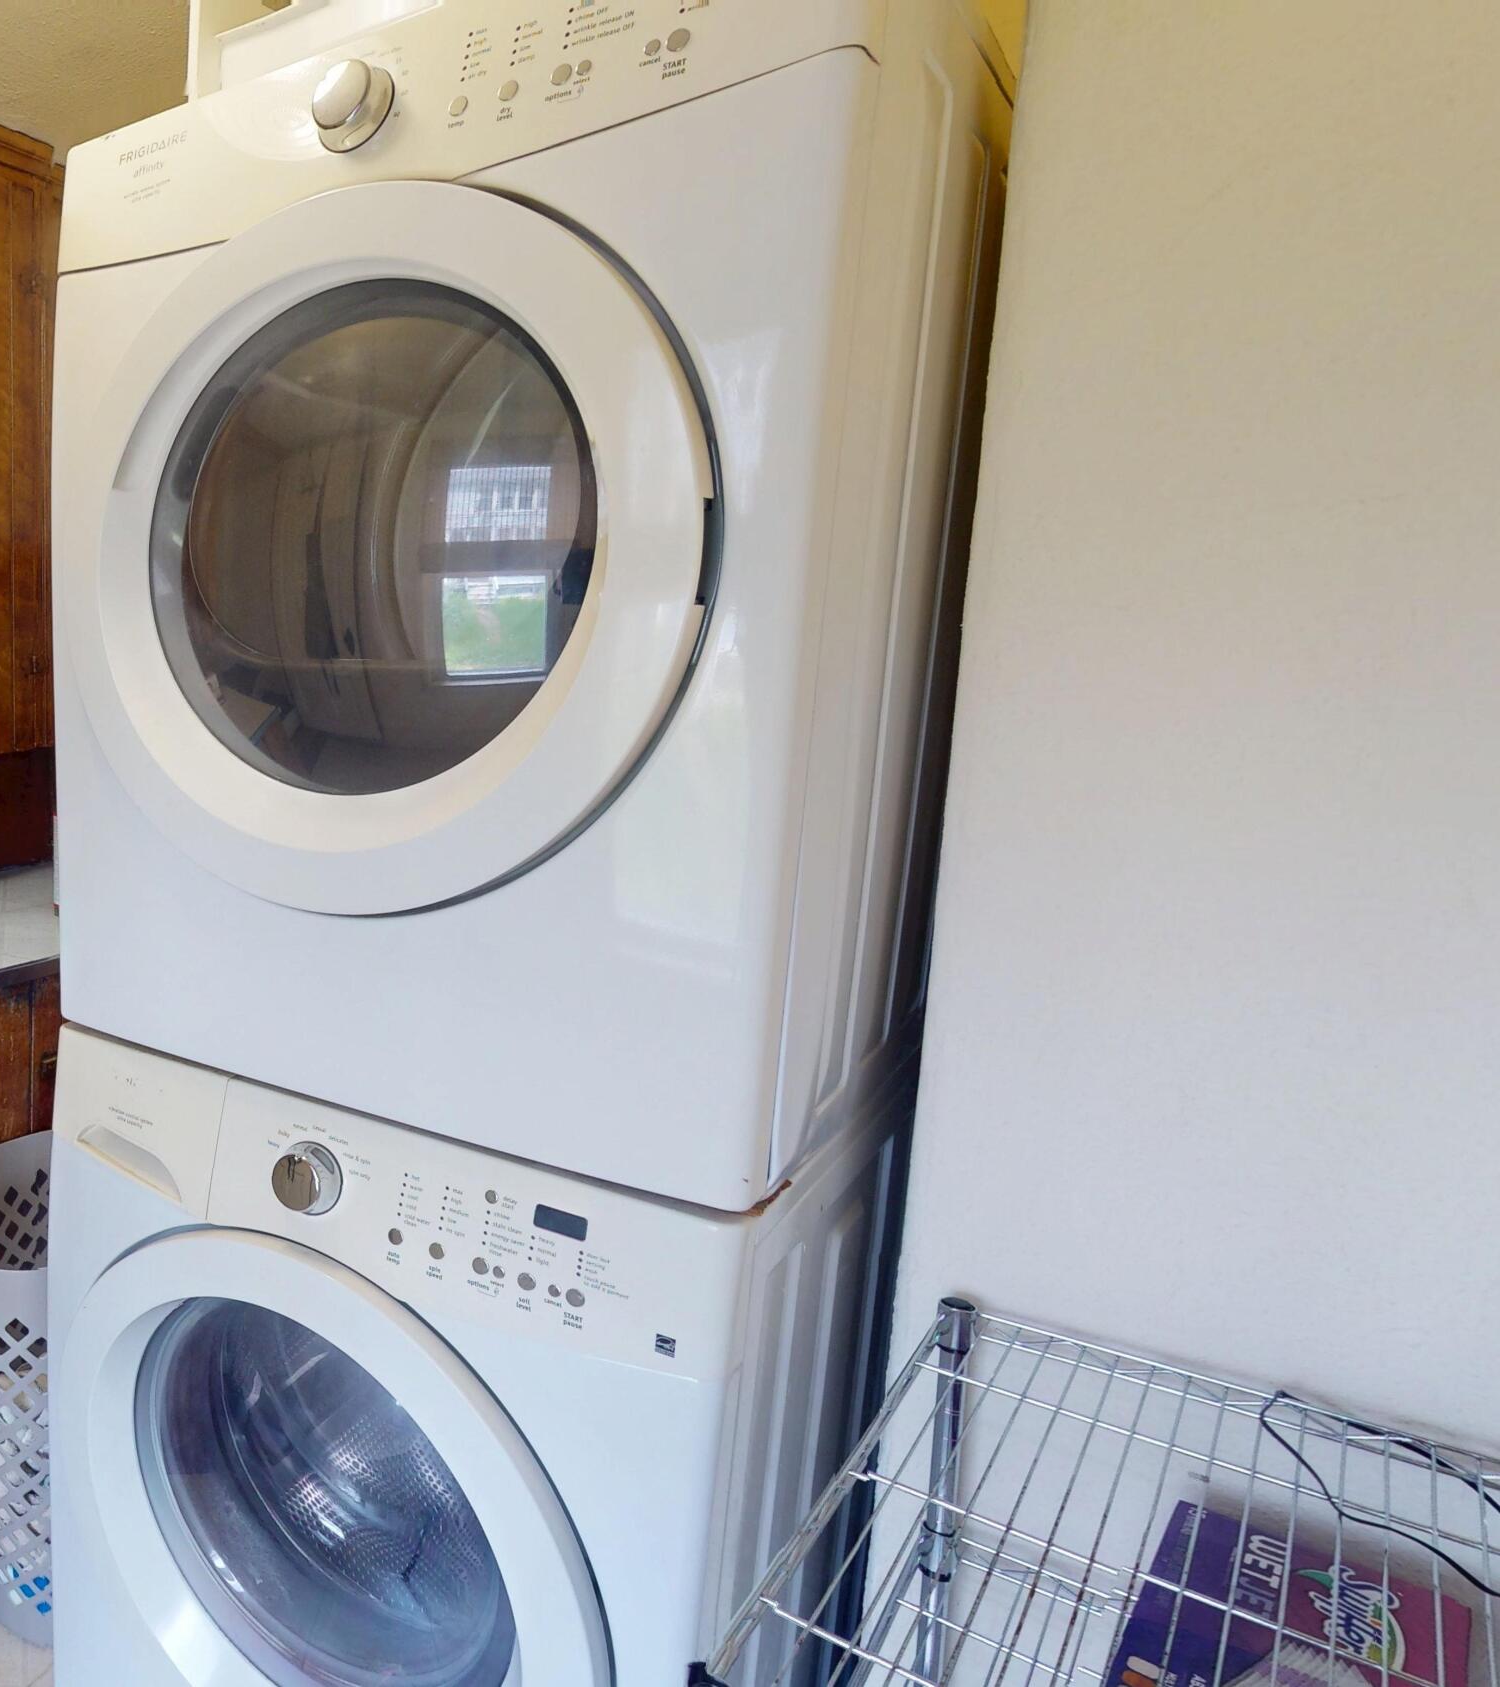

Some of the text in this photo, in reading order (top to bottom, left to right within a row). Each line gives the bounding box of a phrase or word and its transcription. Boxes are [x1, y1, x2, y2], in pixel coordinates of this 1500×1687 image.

[573, 22, 597, 34] wrinkle
[598, 15, 623, 26] release
[571, 21, 635, 46] wrinkle release OFF
[638, 56, 661, 67] cancel
[662, 58, 688, 71] START
[661, 67, 686, 80] pause
[544, 90, 572, 102] options
[500, 106, 511, 114] dry
[496, 112, 513, 121] level
[447, 118, 465, 130] temp
[118, 130, 189, 166] FRIGIDAIRE
[133, 159, 165, 178] affinity
[386, 1255, 400, 1265] temp
[387, 1250, 400, 1259] auto
[425, 1271, 443, 1280] speed
[428, 1265, 441, 1274] spin
[467, 1279, 490, 1291] options
[516, 1302, 531, 1312] level
[518, 1297, 530, 1305] soil
[544, 1298, 562, 1308] cancel
[563, 1311, 583, 1324] START
[563, 1318, 583, 1330] pause
